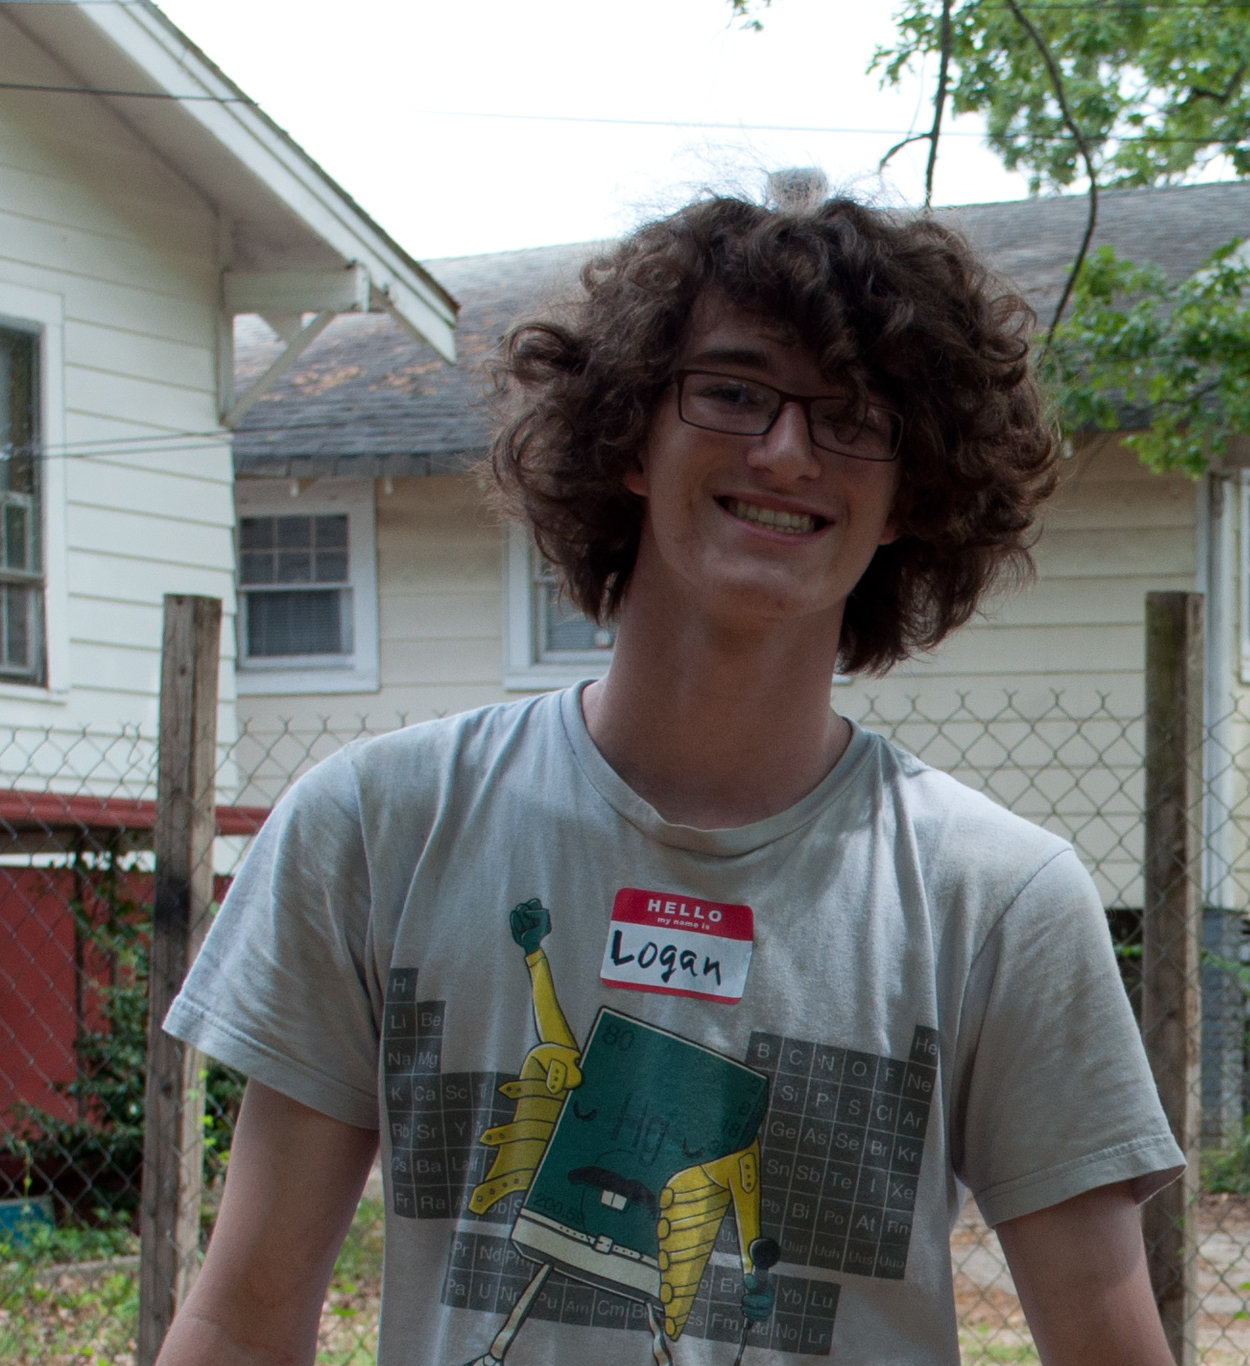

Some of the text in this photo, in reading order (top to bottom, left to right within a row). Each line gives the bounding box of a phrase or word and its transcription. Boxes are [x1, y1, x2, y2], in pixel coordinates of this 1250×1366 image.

[647, 898, 722, 923] HELLO
[657, 917, 711, 931] my name is
[610, 929, 721, 987] Logan
[392, 978, 406, 993] H
[390, 1012, 441, 1029] Li Be
[915, 1036, 938, 1057] He
[387, 1051, 439, 1070] Na Mg
[757, 1042, 932, 1093] B C N O F Ne
[391, 1086, 403, 1101] K
[414, 1086, 436, 1101] Ca
[445, 1084, 468, 1101] Sc
[780, 1084, 799, 1102] Si
[814, 1091, 830, 1108] P
[848, 1098, 862, 1116] S
[902, 1111, 923, 1128] Ar
[416, 1122, 438, 1140] Sr
[454, 1120, 468, 1137] Y
[609, 1092, 670, 1166] Hg
[769, 1119, 797, 1140] Ge
[802, 1129, 827, 1146] As
[834, 1131, 860, 1152] Se
[897, 1144, 918, 1163] Kr
[415, 1158, 441, 1174] Ba
[766, 1158, 790, 1177] Sn
[795, 1164, 821, 1183] Sb
[829, 1170, 853, 1189] Te
[891, 1181, 914, 1200] Xe
[420, 1194, 446, 1210] Ra
[791, 1201, 810, 1220] Bi
[824, 1209, 844, 1226] Po
[855, 1213, 876, 1232] At
[479, 1245, 505, 1261] Nd
[720, 1277, 742, 1294] Er
[781, 1286, 802, 1305] Yb
[812, 1289, 833, 1309] Lu
[479, 1283, 492, 1300] U
[596, 1300, 625, 1318] Cm
[711, 1312, 739, 1332] Fm
[775, 1322, 799, 1341] No
[807, 1327, 826, 1345] Lr
